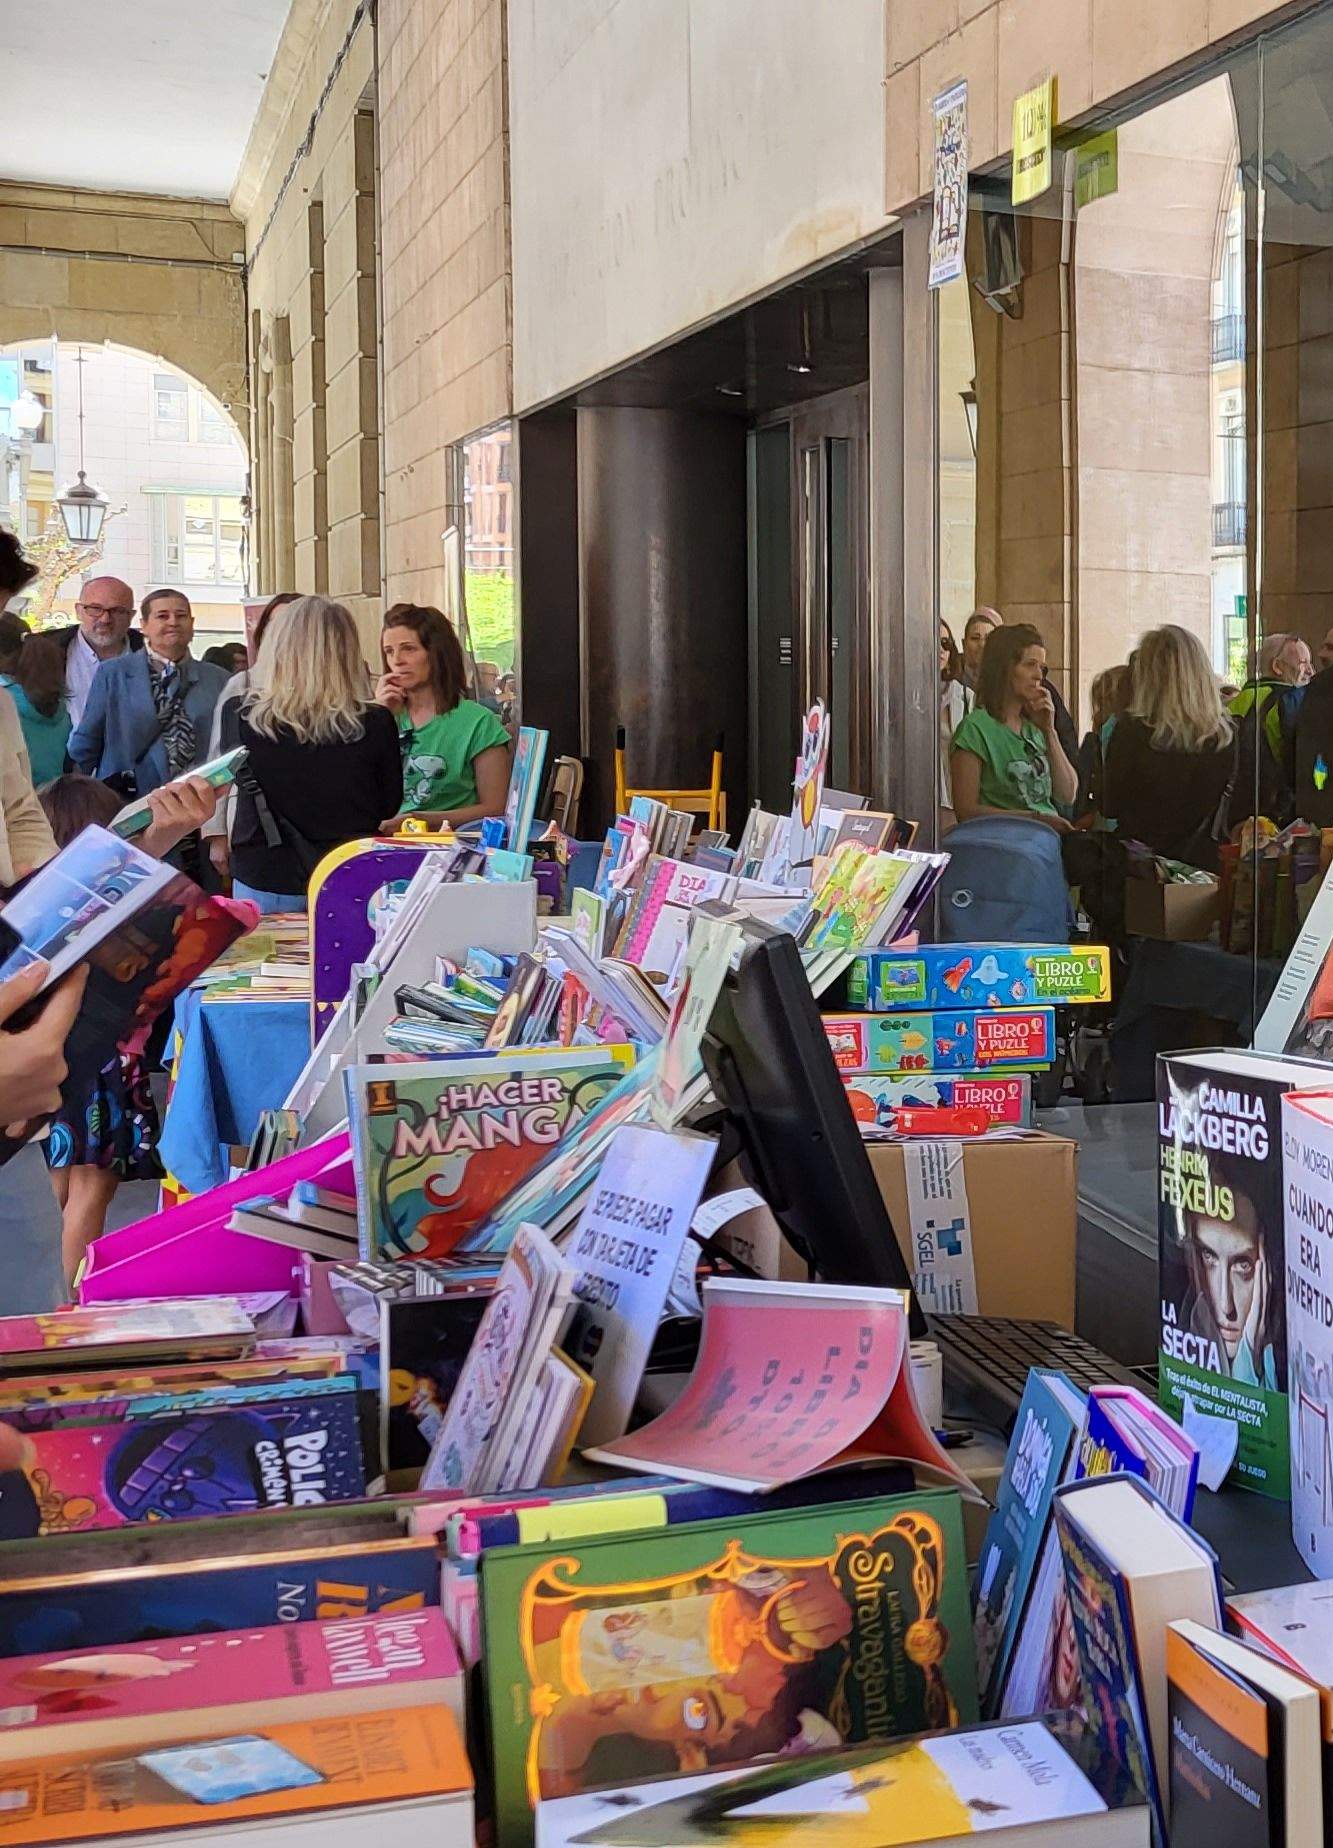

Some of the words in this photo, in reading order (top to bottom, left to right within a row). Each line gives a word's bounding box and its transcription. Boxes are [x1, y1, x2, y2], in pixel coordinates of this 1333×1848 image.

[1036, 962, 1083, 976] LIBRO
[1036, 977, 1045, 987] Y
[1047, 976, 1085, 987] PUZLE
[978, 1023, 1029, 1039] LIBRO
[978, 1040, 987, 1050] Y
[990, 1038, 1030, 1050] PUZLE
[438, 1079, 565, 1120] ¡HACER
[955, 1088, 1005, 1103] LIBRO
[1199, 1082, 1266, 1122] CAMILLA
[917, 1231, 934, 1268] SGEL
[1300, 1234, 1321, 1277] ERA
[1161, 1299, 1177, 1332] LA
[1161, 1325, 1221, 1374] SECTA
[1202, 1382, 1211, 1393] de
[1211, 1385, 1220, 1397] EL
[1214, 1402, 1226, 1415] por
[1226, 1405, 1236, 1418] LA
[1237, 1408, 1261, 1428] SECTA
